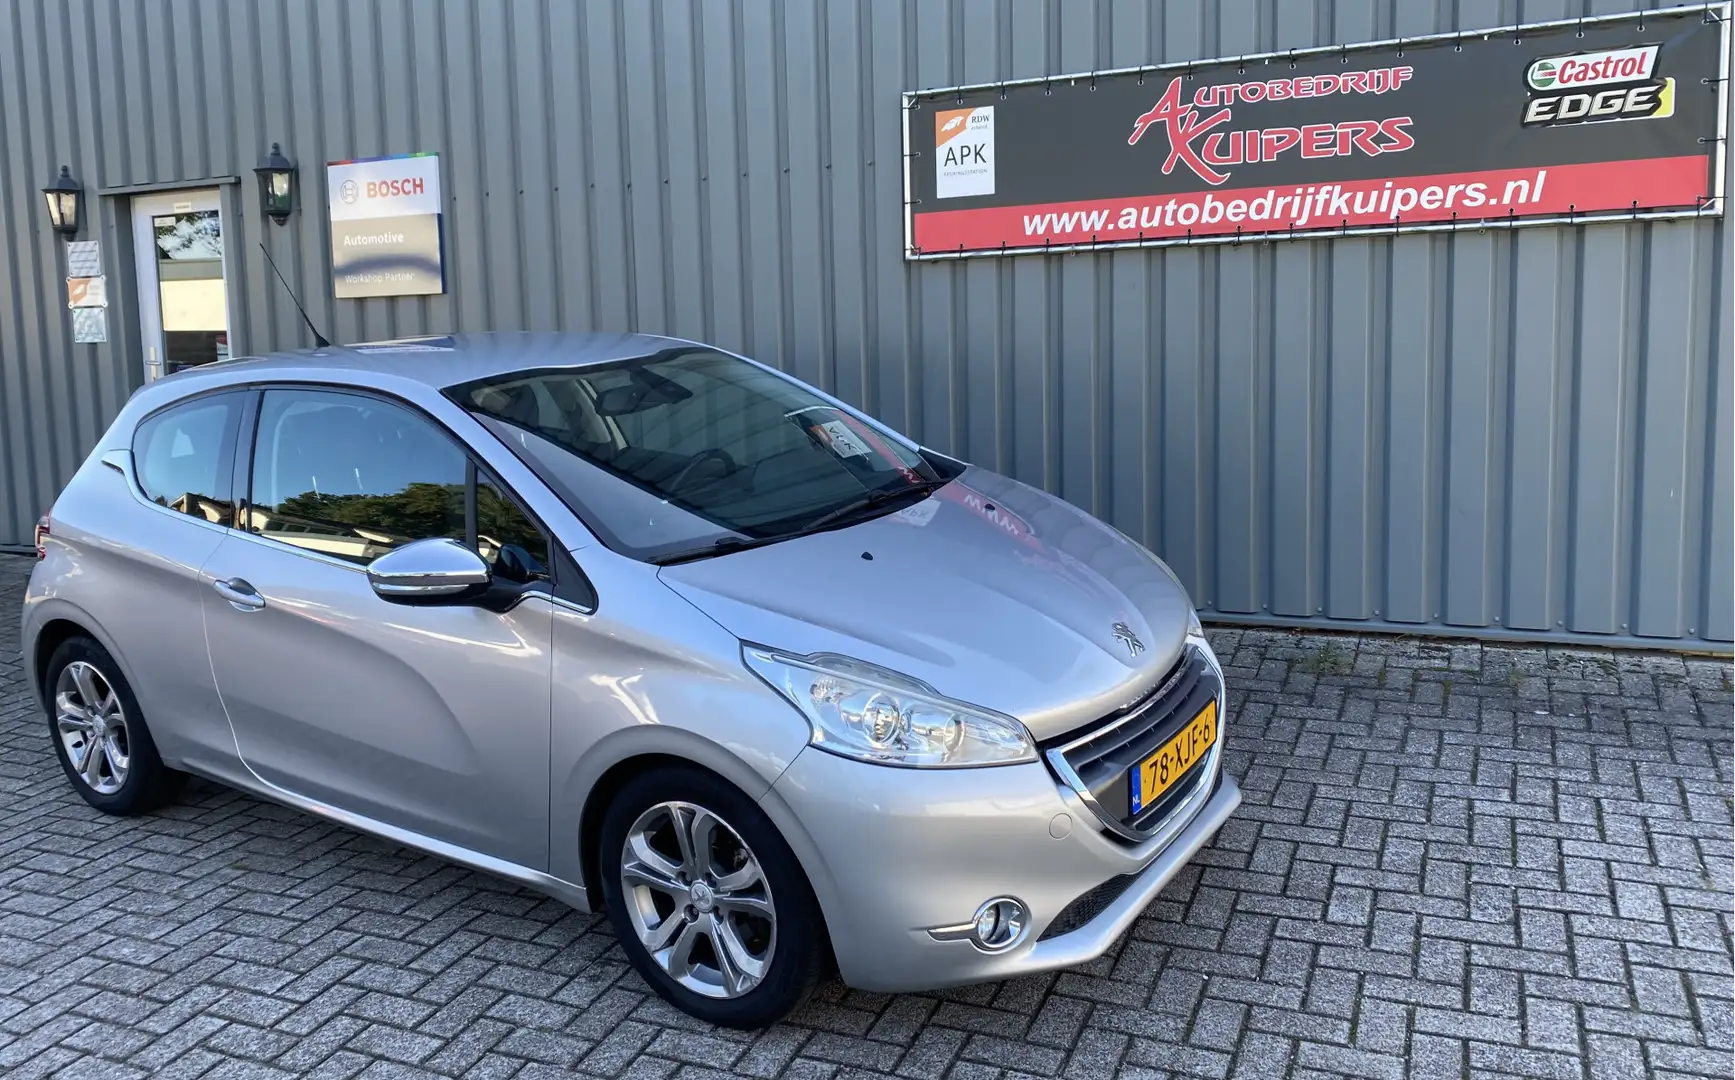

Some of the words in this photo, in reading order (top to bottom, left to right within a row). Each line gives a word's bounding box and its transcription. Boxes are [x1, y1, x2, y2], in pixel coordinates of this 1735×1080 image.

[1558, 51, 1647, 84] Castrol
[1128, 66, 1413, 145] AUTOBEDRIJF
[1524, 85, 1662, 123] EDGE
[971, 115, 989, 123] RDW
[944, 143, 986, 167] APK
[1161, 108, 1414, 185] KUIPERS
[366, 177, 424, 198] BOSCH
[1022, 170, 1547, 236] www.autobedrijfkuipers.nl
[343, 231, 404, 246] Automotive
[345, 274, 382, 284] Workshop
[385, 273, 414, 281] Partner
[1149, 713, 1210, 795] 78-XJF-6
[1132, 795, 1141, 806] NL
